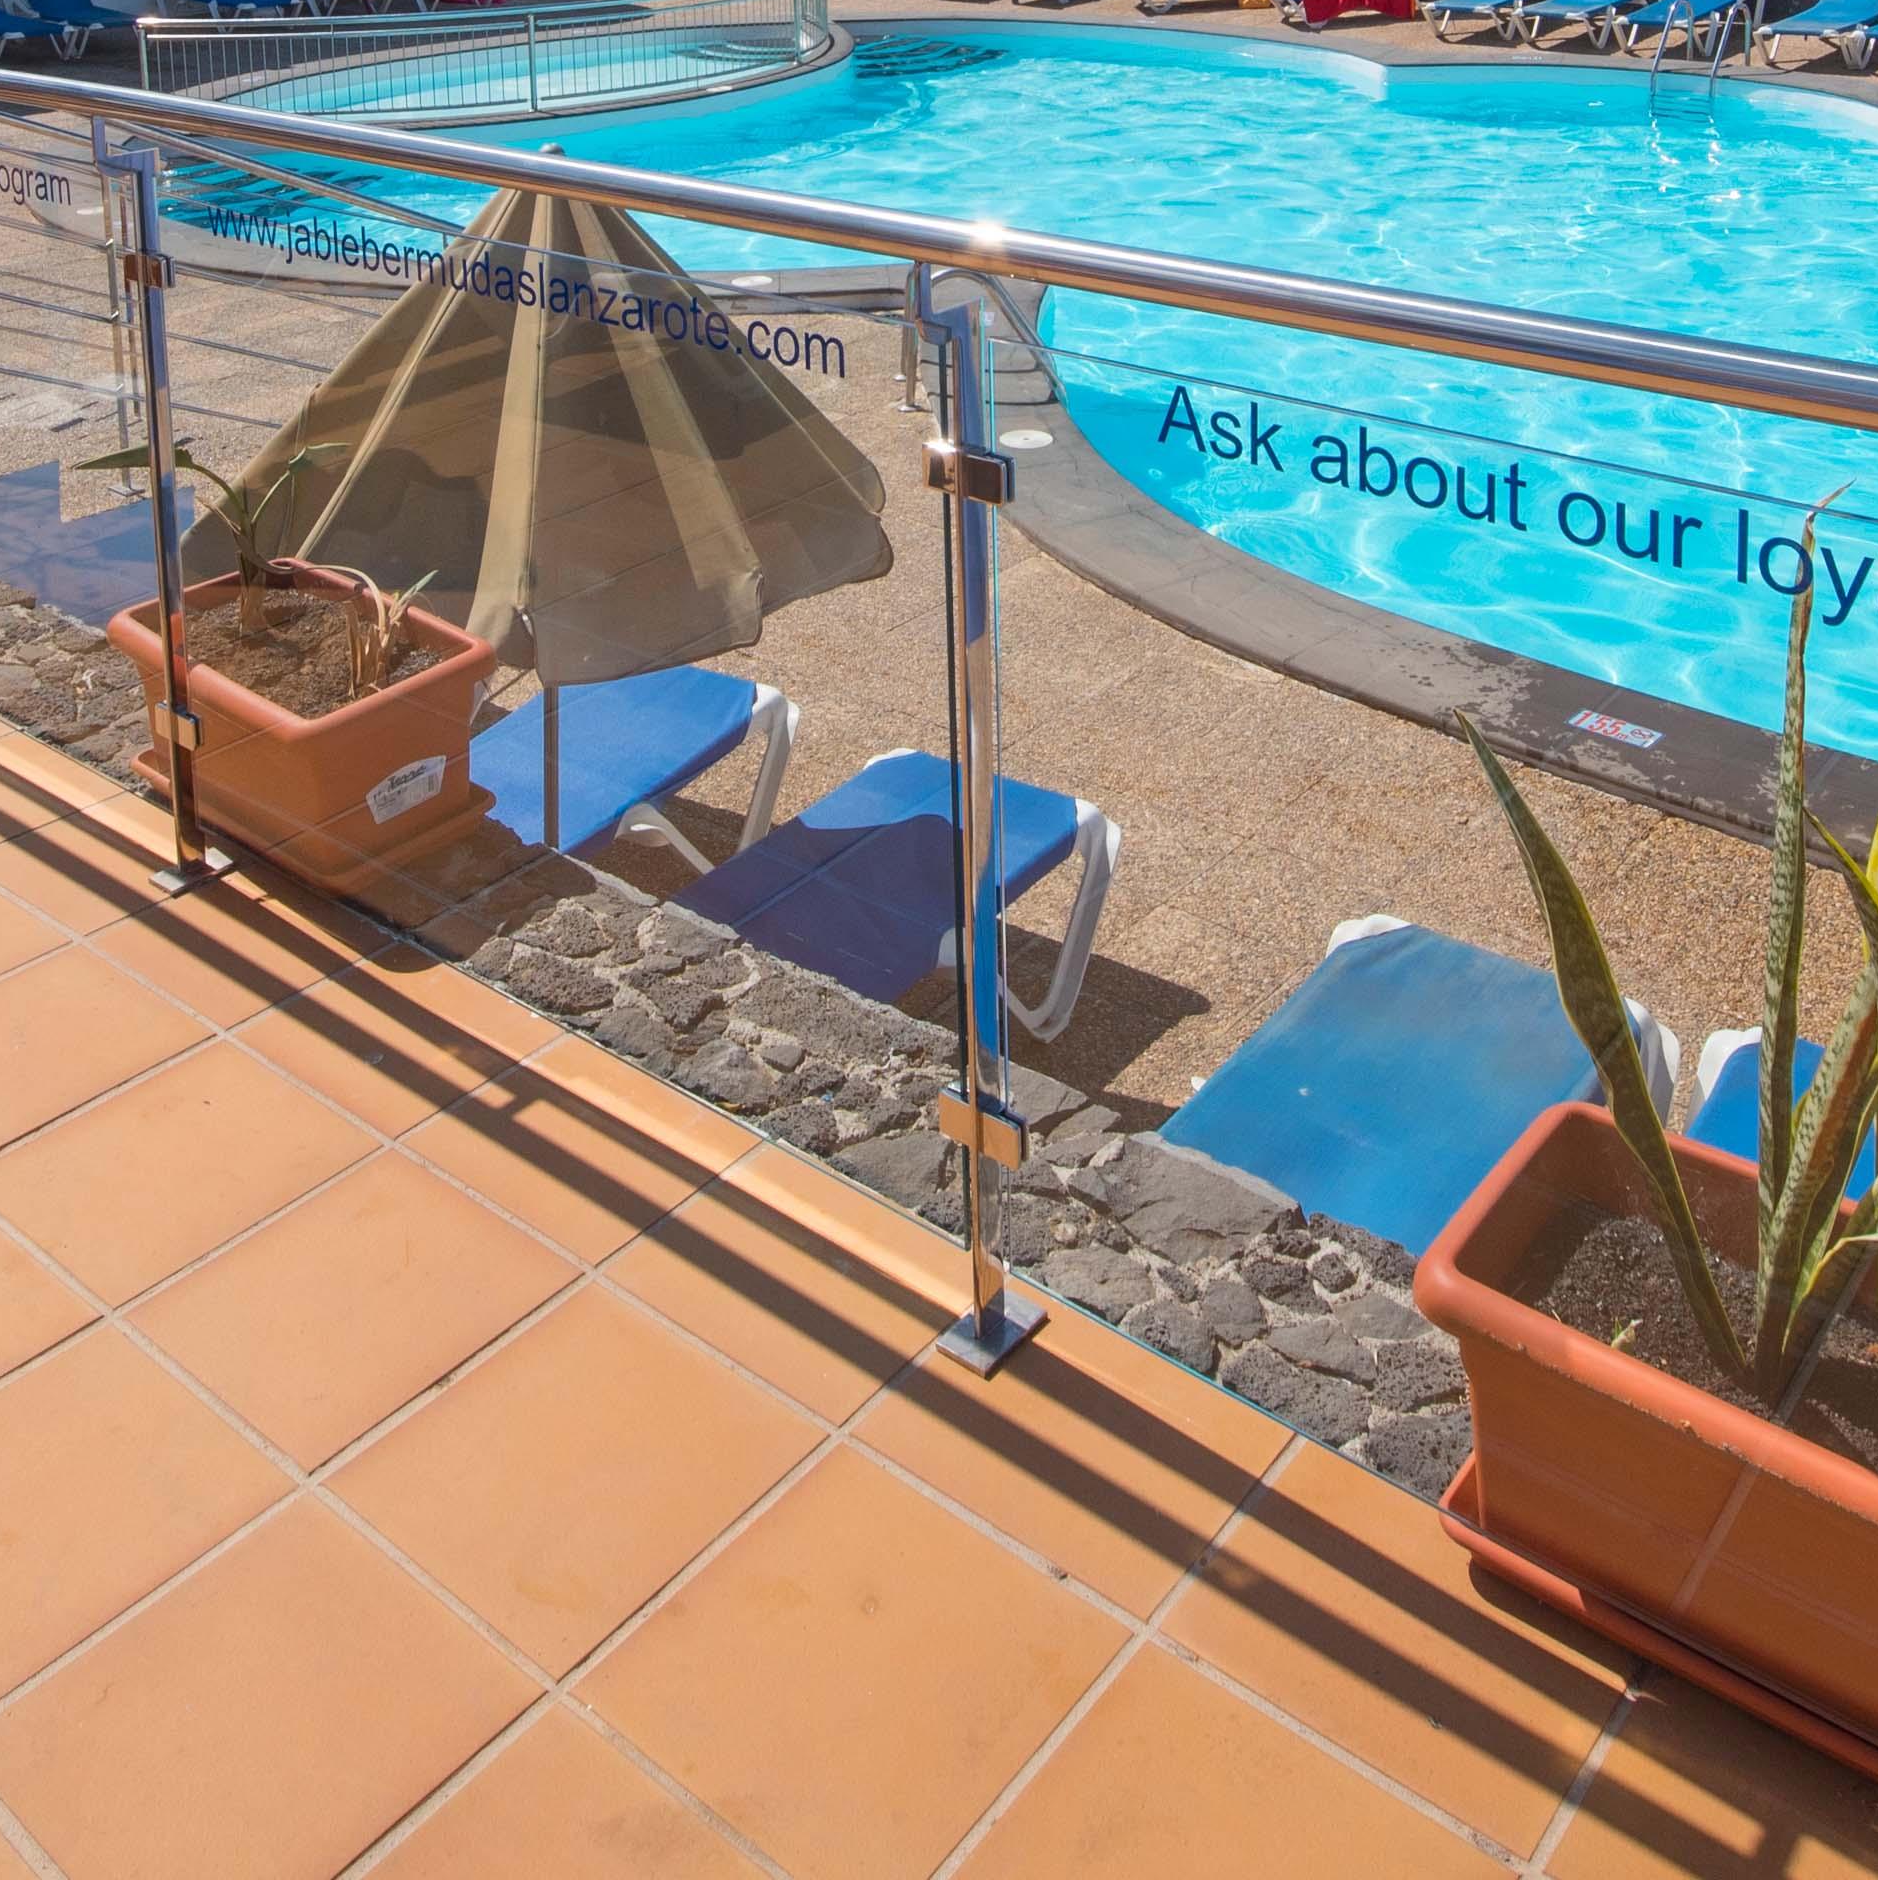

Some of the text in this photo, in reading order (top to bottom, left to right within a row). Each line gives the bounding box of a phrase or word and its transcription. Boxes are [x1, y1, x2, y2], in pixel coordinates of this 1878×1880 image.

[206, 204, 846, 378] www.jablebermudaslanzarote.com
[1157, 385, 1284, 472] Ask
[1310, 426, 1527, 531] about
[1558, 491, 1702, 569] our
